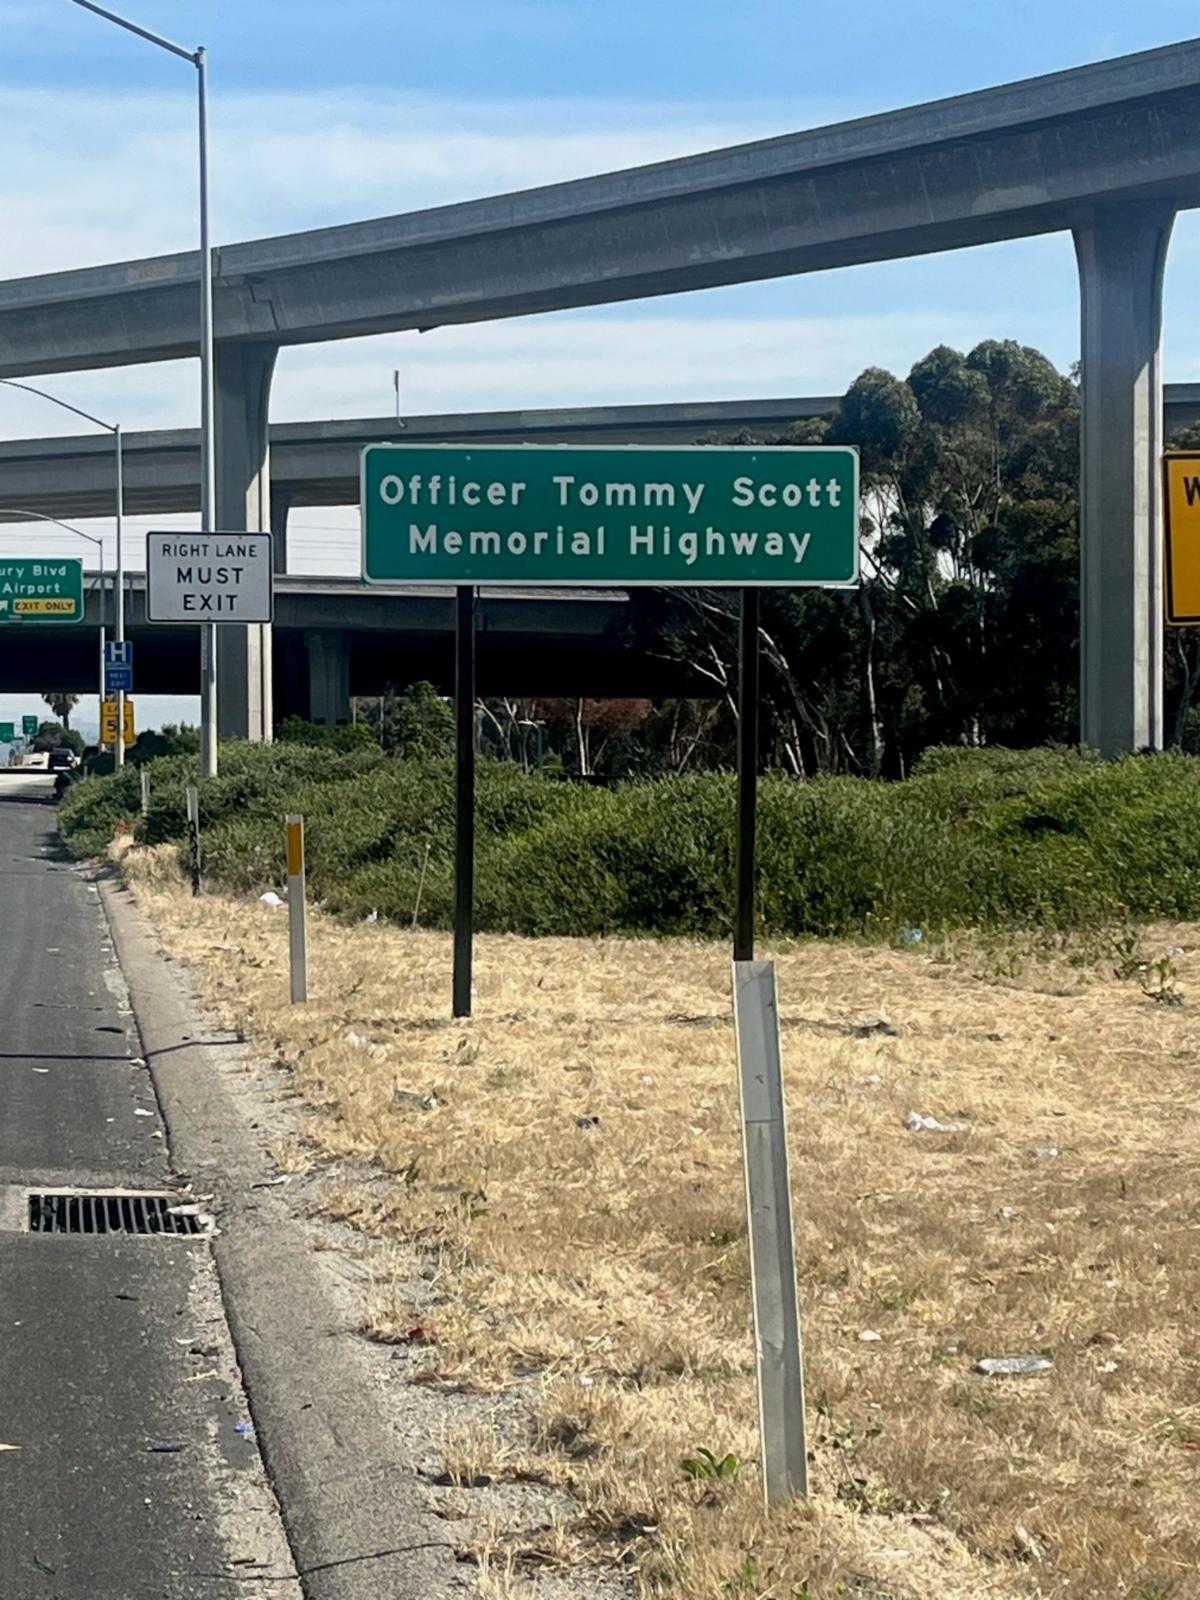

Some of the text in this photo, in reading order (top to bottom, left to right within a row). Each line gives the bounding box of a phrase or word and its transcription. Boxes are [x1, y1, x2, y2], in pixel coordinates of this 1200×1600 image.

[379, 474, 842, 514] Officer Tommy Scott
[162, 543, 258, 558] RIGHT LANE
[409, 524, 812, 565] Memorial Highway
[32, 564, 67, 576] Blvd
[177, 567, 244, 584] MUST
[2, 582, 61, 595] Airport
[15, 601, 73, 611] EXIT ONLY
[183, 594, 239, 611] EXIT
[110, 642, 126, 662] H
